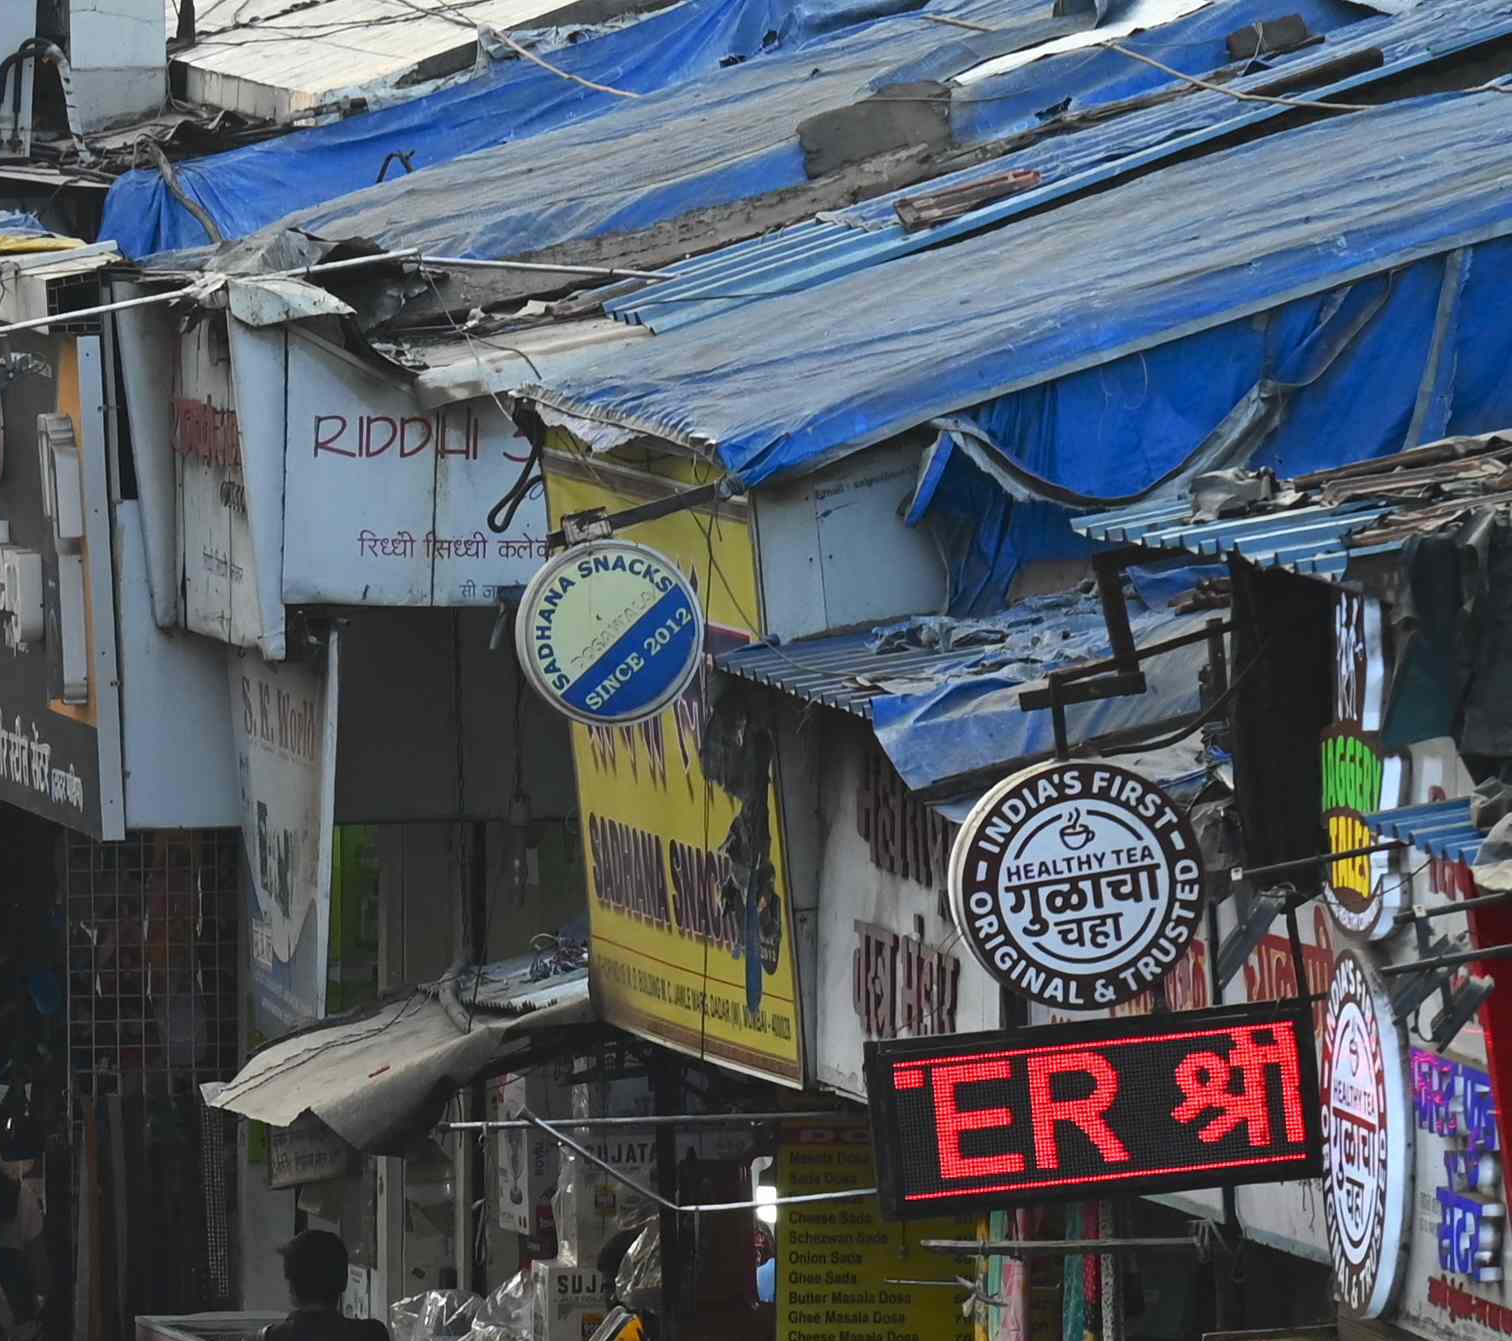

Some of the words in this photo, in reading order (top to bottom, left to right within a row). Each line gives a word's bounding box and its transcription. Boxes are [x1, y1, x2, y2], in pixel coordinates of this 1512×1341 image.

[313, 414, 479, 460] RIDDHI
[535, 576, 576, 694] SADHANA
[577, 555, 674, 594] SNACKS
[585, 652, 645, 710] SINCE
[644, 607, 692, 656] 2012
[277, 686, 316, 764] World
[978, 771, 1083, 855] INDIA'S
[1092, 772, 1179, 830] FIRST
[589, 811, 672, 934] SADHANA
[1006, 851, 1107, 883] HEALTHY
[1111, 845, 1155, 866] TEA
[1329, 815, 1371, 899] TALES
[969, 891, 1084, 1004] ORIGINAL
[1094, 978, 1117, 1003] &
[1119, 858, 1200, 992] TRUSTED
[1004, 863, 1161, 937] गुळाचा
[1053, 912, 1124, 949] चहा
[1325, 958, 1355, 1046] INDIA'S
[1356, 969, 1382, 1070] FIRST
[1170, 1021, 1308, 1147] श्री
[1333, 1078, 1362, 1110] HEALTHY
[1362, 1089, 1376, 1116] TEA
[584, 1141, 657, 1164] SUJATA
[1333, 1107, 1377, 1190] गुळाचा
[789, 1212, 834, 1224] Cheese
[1321, 1112, 1352, 1303] ORIGINAL
[1345, 1177, 1365, 1230] चहा
[789, 1252, 826, 1265] Onion
[789, 1272, 821, 1284] Ghee
[825, 1272, 856, 1284] Sada
[789, 1291, 827, 1304] Butter
[832, 1291, 877, 1304] Masala
[789, 1311, 821, 1324] Ghee
[825, 1311, 869, 1324] Masala
[873, 1311, 905, 1324] Dosa
